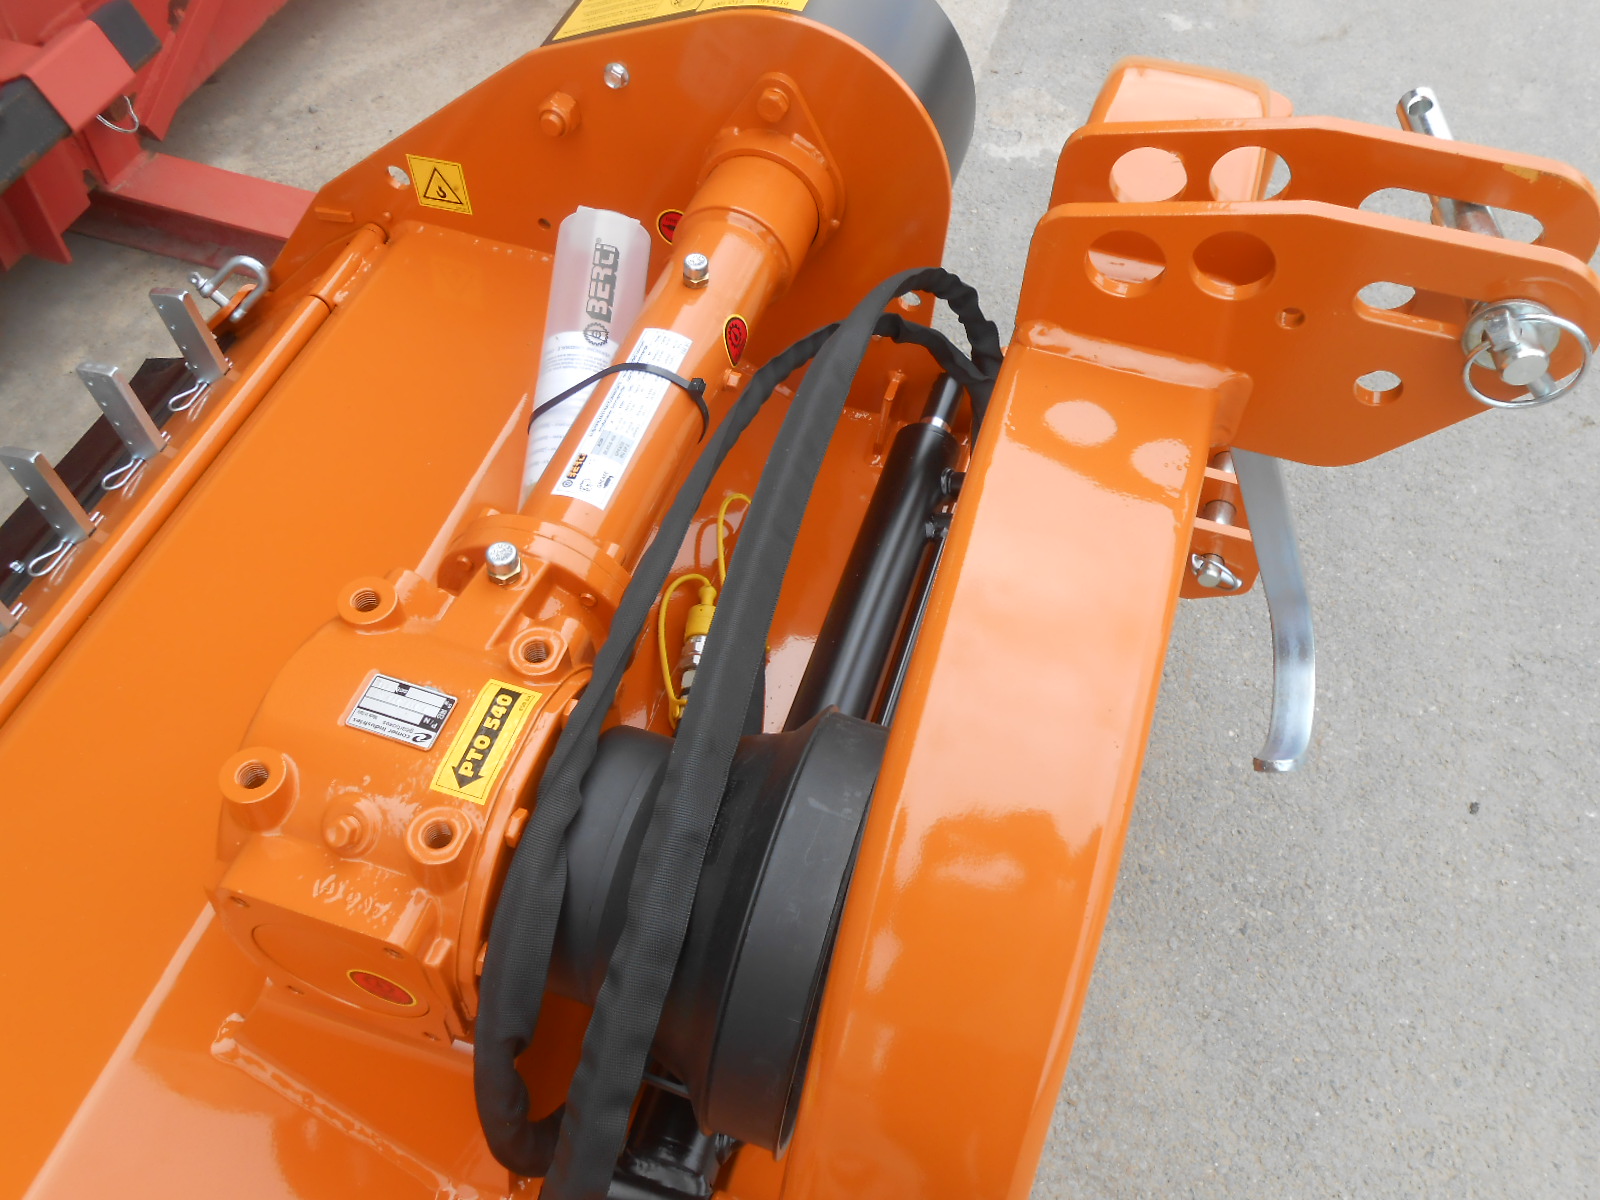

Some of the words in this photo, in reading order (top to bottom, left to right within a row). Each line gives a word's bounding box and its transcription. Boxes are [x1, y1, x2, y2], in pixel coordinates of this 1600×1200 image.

[353, 717, 387, 732] industries
[422, 717, 438, 729] P/N
[388, 728, 411, 739] comer
[458, 734, 491, 777] PTO
[483, 694, 513, 731] 540
